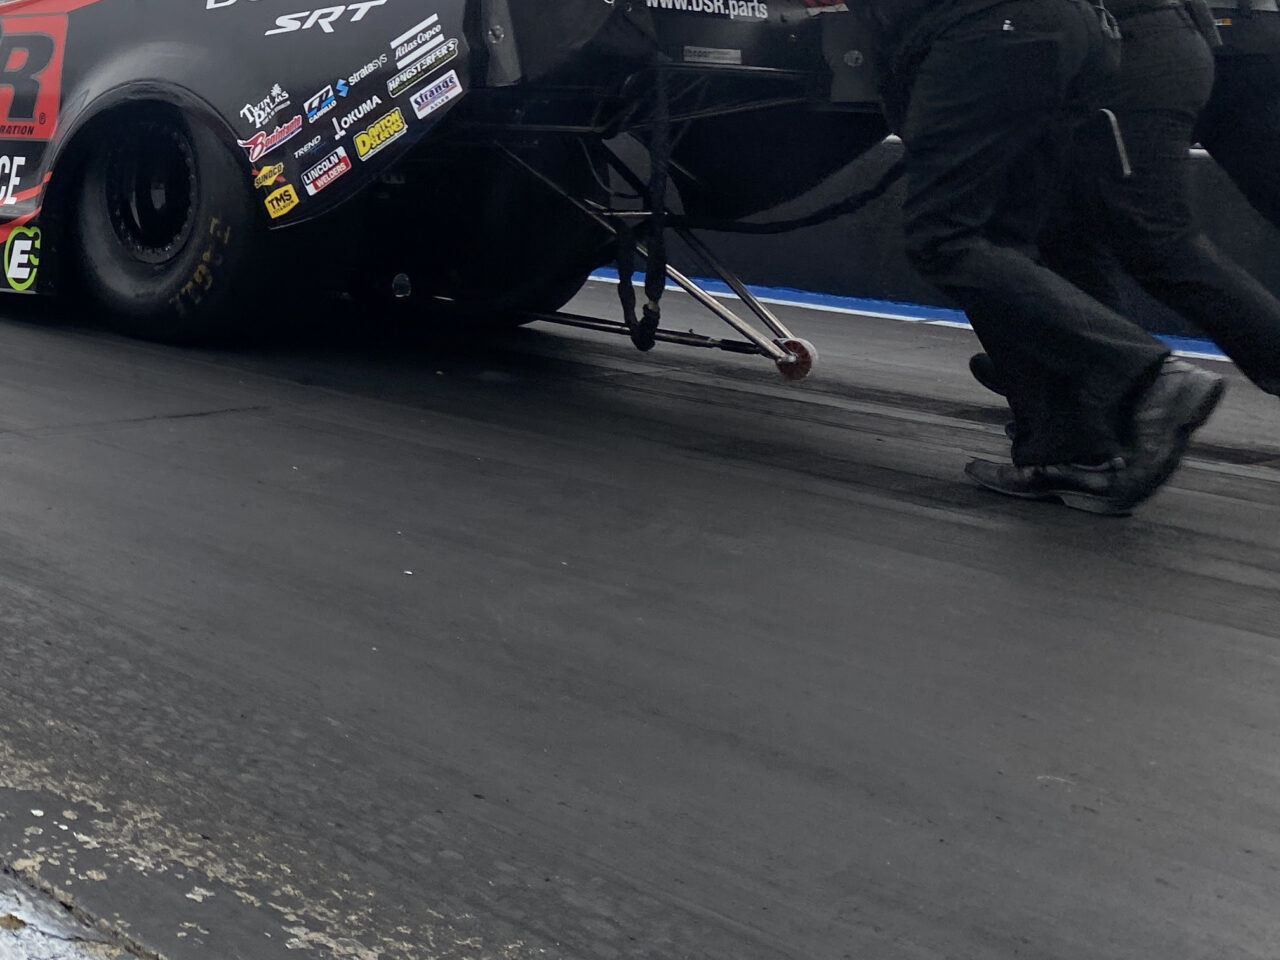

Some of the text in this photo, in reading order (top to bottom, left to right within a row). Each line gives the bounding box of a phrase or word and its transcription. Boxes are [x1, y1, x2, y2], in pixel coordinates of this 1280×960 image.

[264, 0, 388, 34] SRT
[395, 24, 442, 60] Atlas Copco
[348, 53, 388, 86] stratasys
[388, 40, 455, 91] HANGSTERFER'S
[341, 95, 382, 128] OKUMA
[294, 135, 321, 159] TREND
[255, 163, 283, 187] SUNOCO
[303, 153, 339, 185] LINCOLN
[316, 162, 347, 188] WELDERS
[268, 190, 292, 209] TMS
